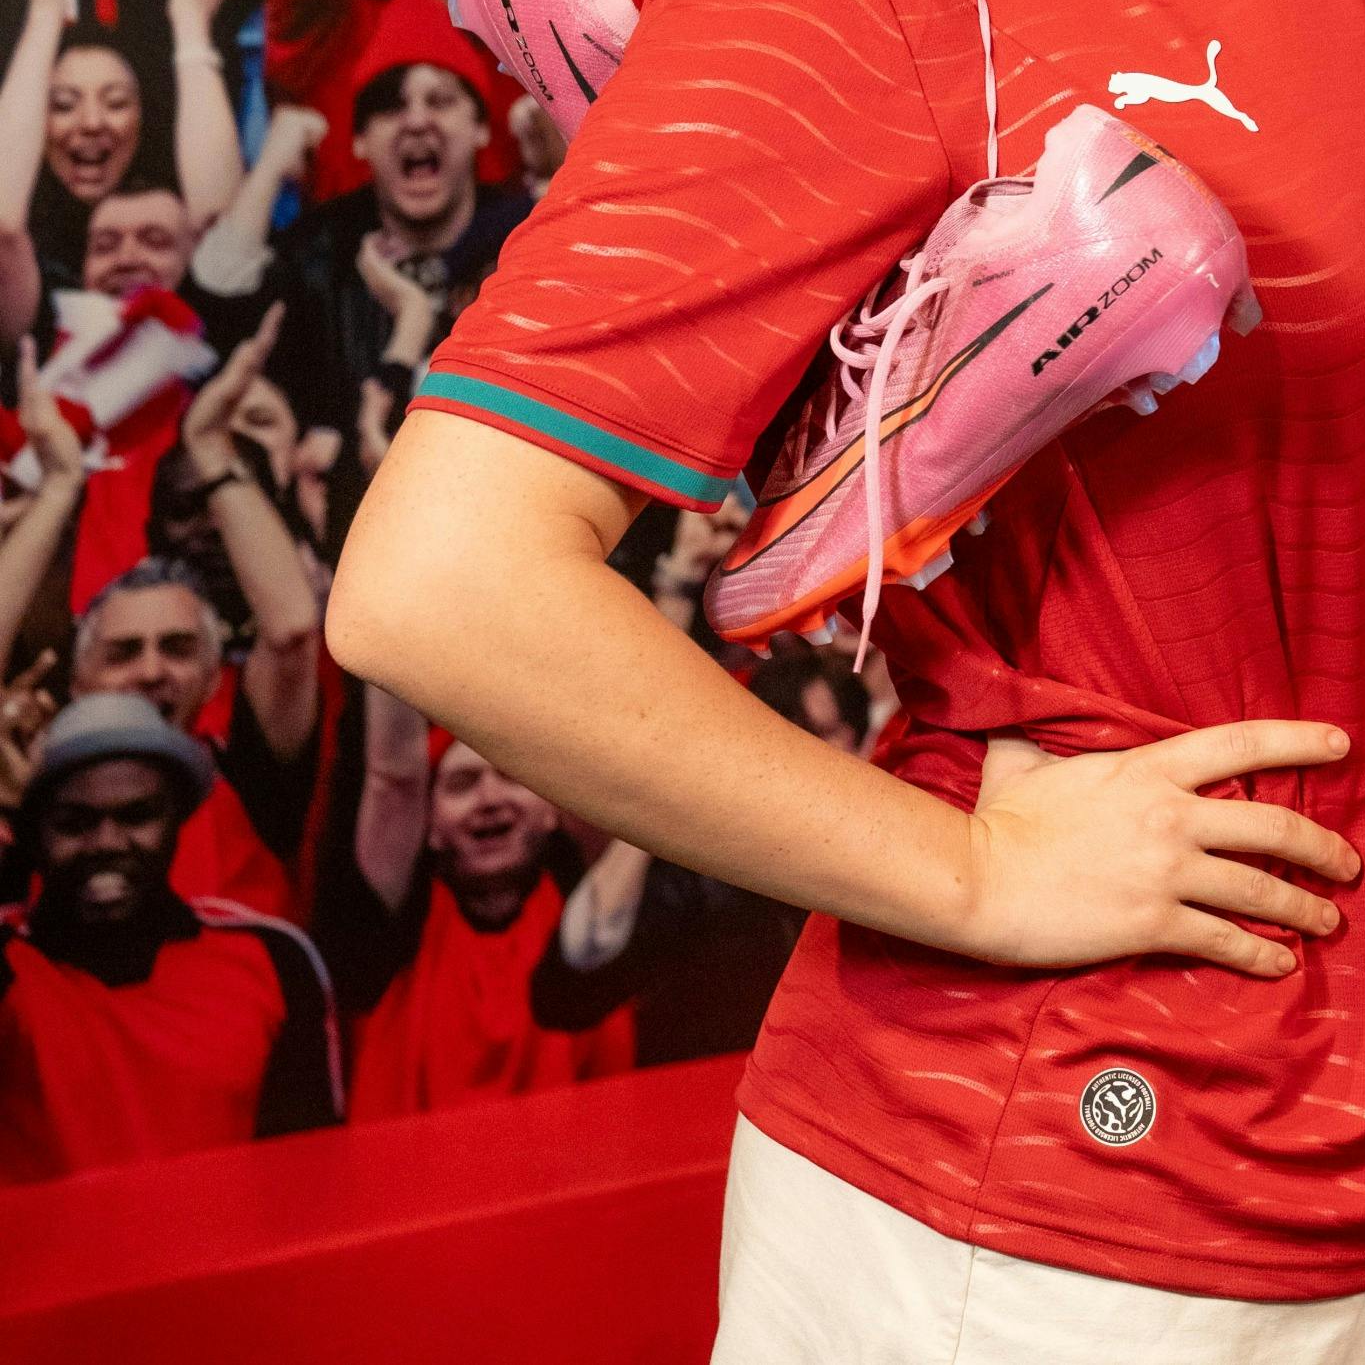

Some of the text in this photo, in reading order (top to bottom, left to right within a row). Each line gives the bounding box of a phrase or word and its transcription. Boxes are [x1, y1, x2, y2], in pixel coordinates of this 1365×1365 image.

[515, 36, 554, 101] ZOOM
[1031, 247, 1163, 376] AIR ZOOM
[1091, 1072, 1117, 1092] AUTHENTIC
[1117, 1072, 1142, 1087] LICENSED
